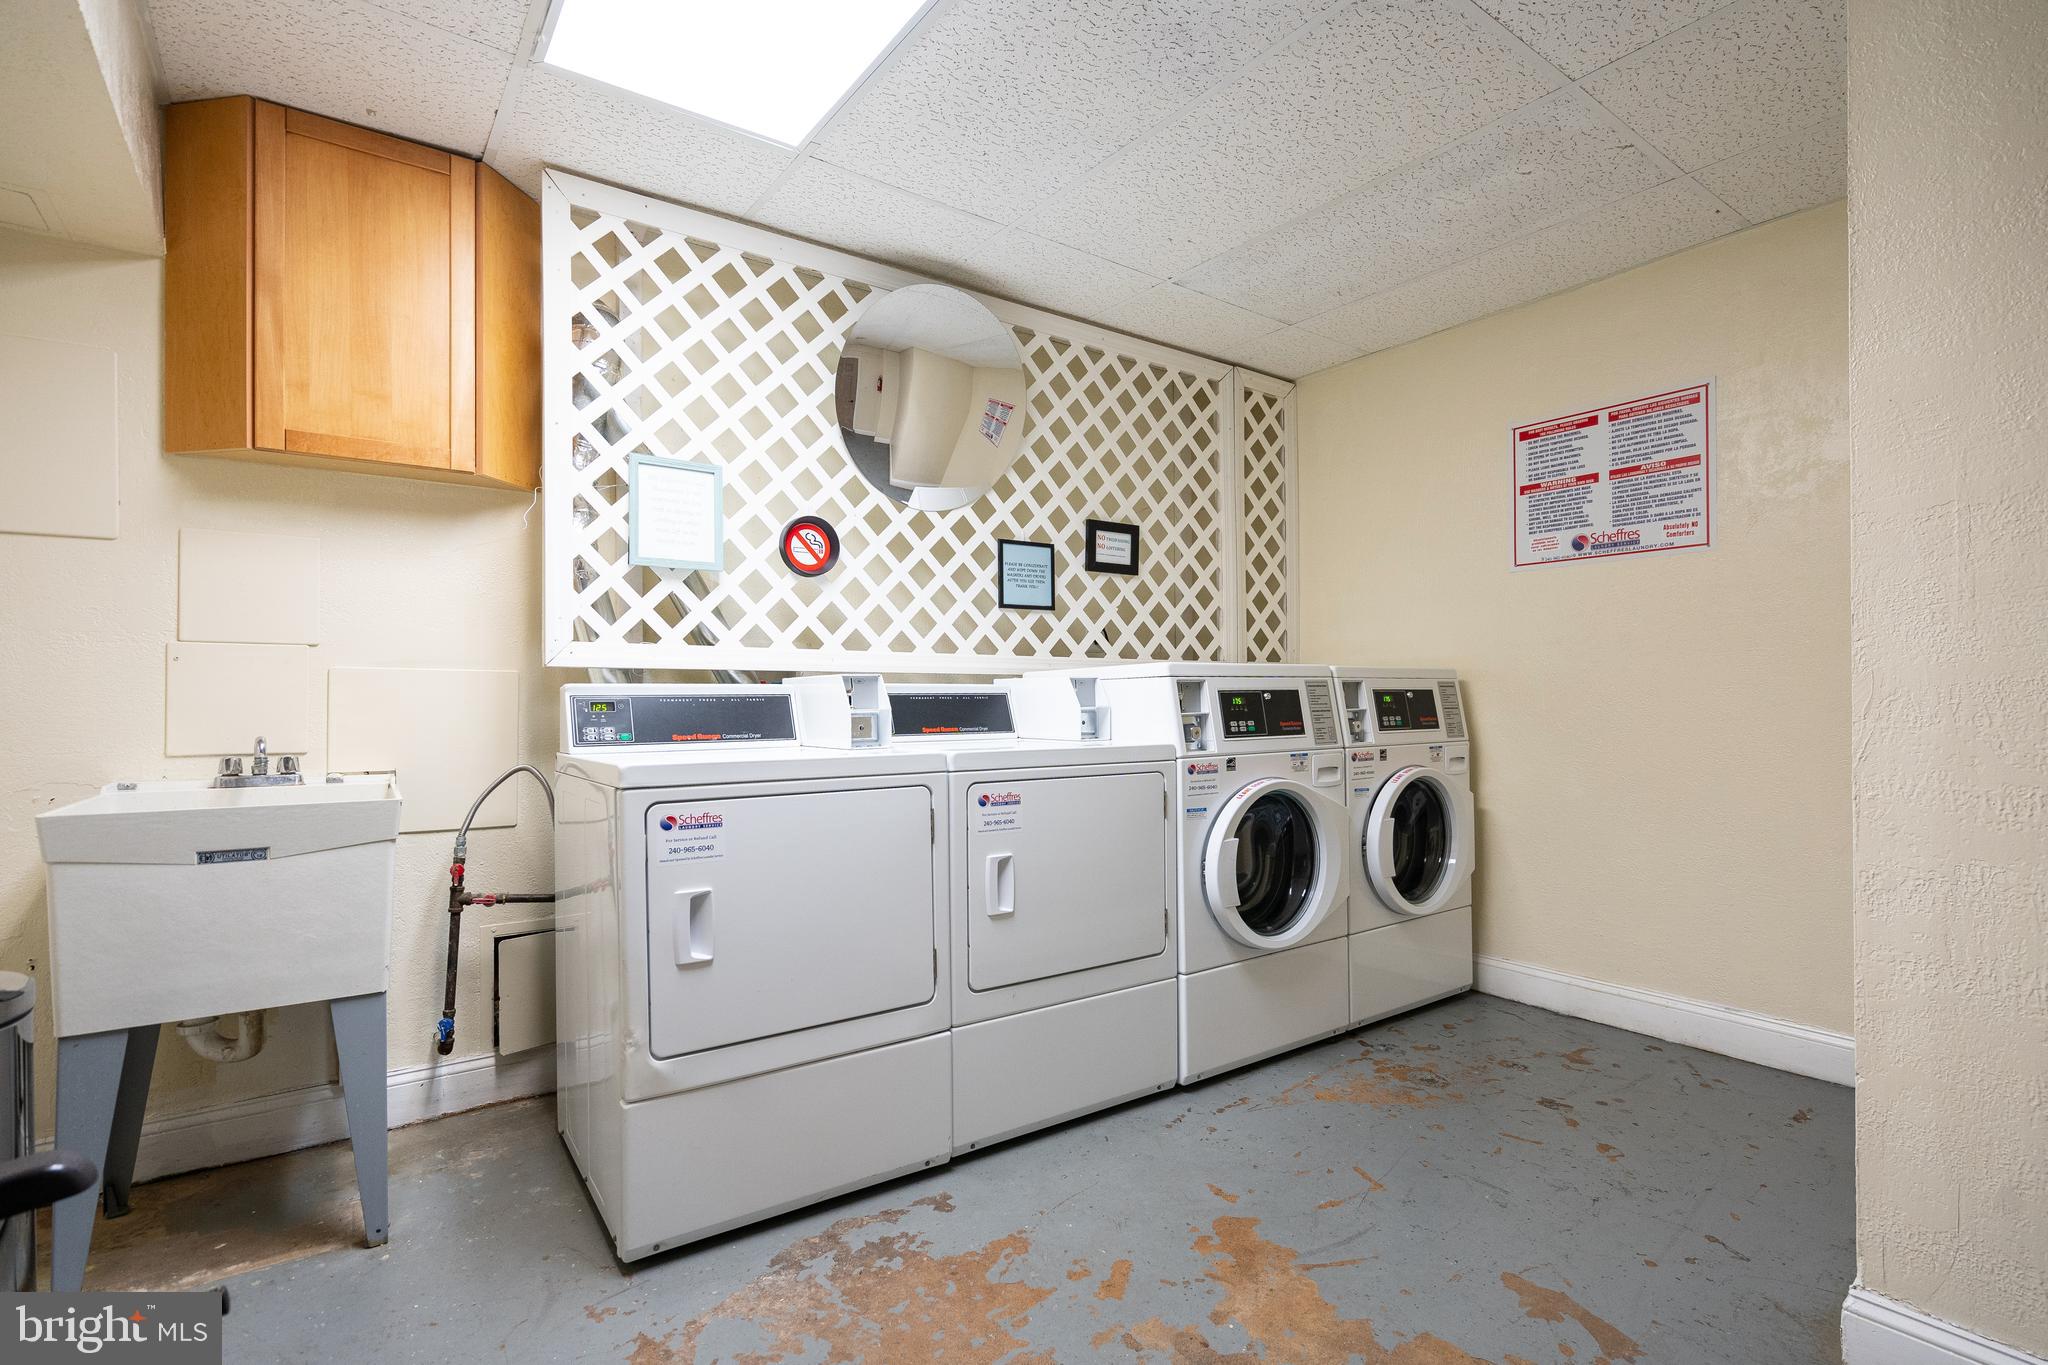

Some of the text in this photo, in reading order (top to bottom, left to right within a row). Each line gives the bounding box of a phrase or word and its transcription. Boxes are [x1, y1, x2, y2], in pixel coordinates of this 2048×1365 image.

[1640, 461, 1667, 471] AVISO
[1540, 477, 1577, 488] WARNING
[1663, 521, 1690, 532] Absolutely
[1590, 528, 1640, 545] Scheffres
[1666, 529, 1695, 538] Comforters
[592, 703, 607, 712] 125
[990, 792, 1021, 802] Scheffres
[678, 812, 723, 825] Scheffres
[983, 819, 1016, 827] 240-965-6040
[668, 844, 715, 855] 240-965-6040
